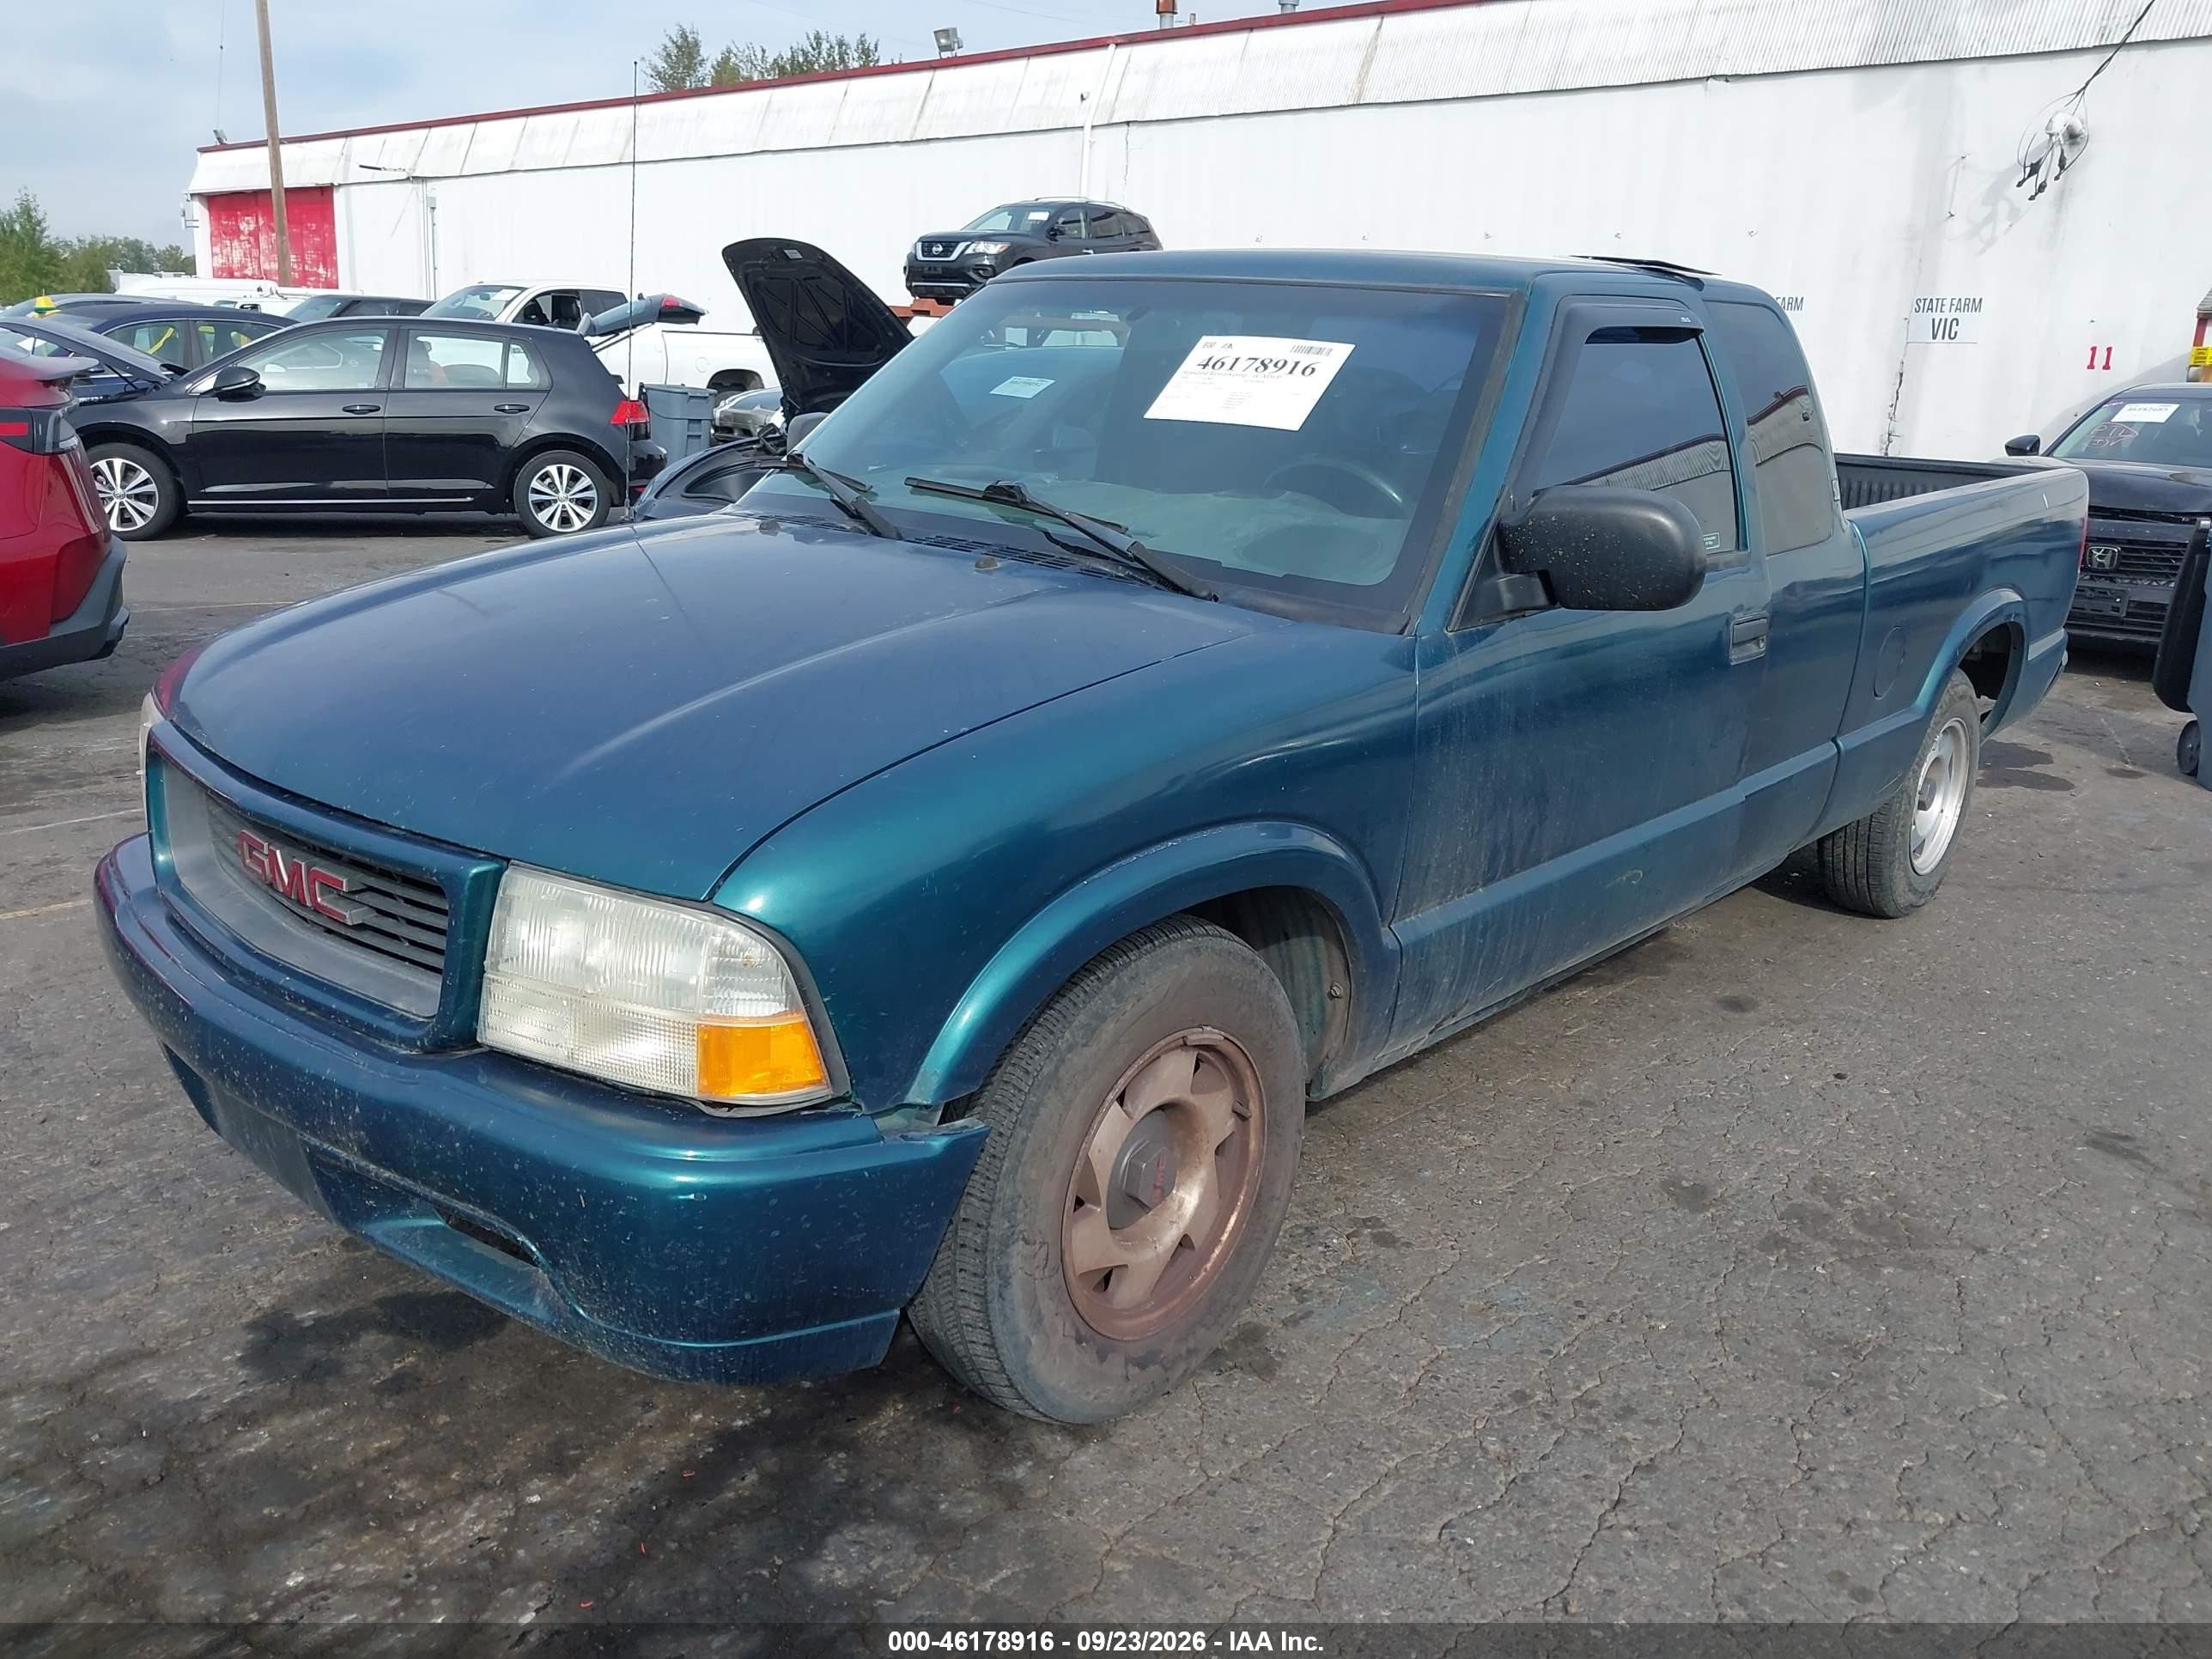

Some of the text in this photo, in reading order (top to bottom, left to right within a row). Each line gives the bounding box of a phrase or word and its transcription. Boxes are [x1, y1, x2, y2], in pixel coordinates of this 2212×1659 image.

[1914, 297, 1984, 313] STATE FARM
[1931, 318, 1960, 341] VIC
[1197, 355, 1322, 377] 46178916
[2087, 346, 2113, 370] 11
[238, 830, 354, 927] GMC
